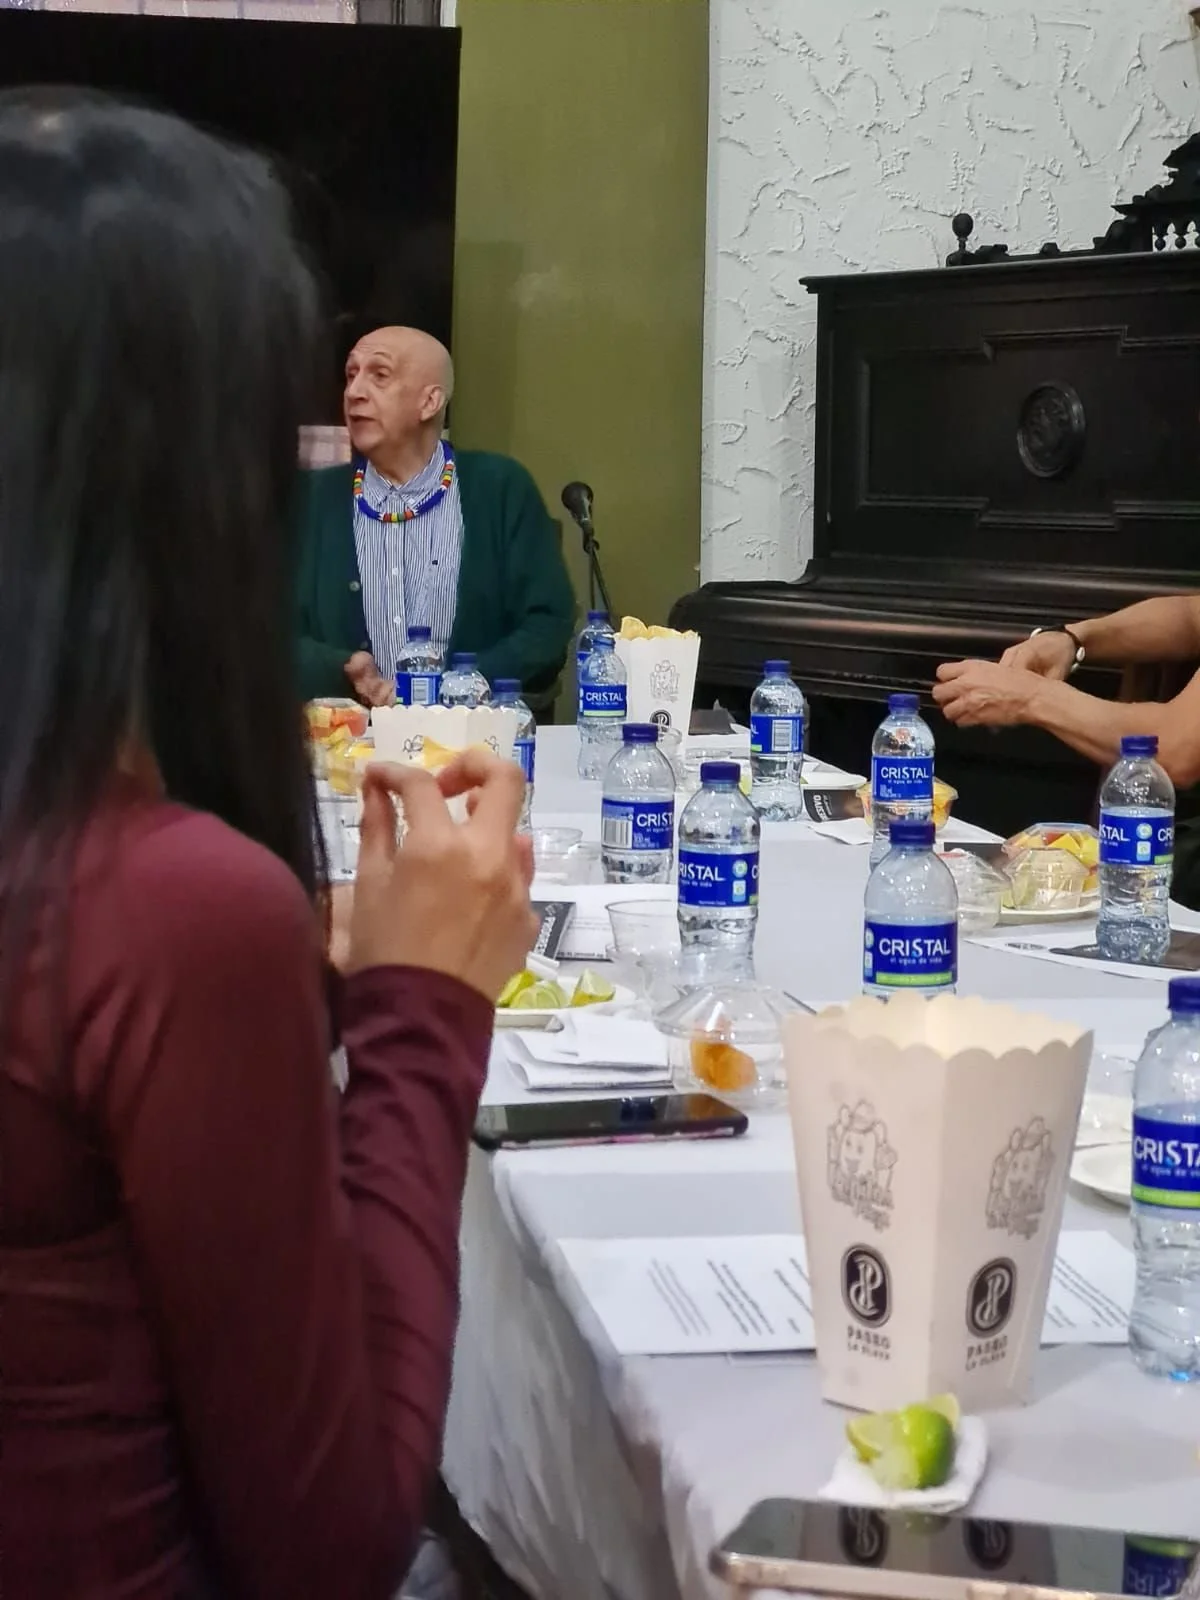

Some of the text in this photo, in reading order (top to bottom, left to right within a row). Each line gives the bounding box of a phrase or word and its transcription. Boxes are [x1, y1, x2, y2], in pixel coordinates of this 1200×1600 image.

[585, 692, 624, 702] CRISTAL
[880, 766, 930, 779] CRISTAL
[636, 812, 673, 827] CRIST
[1099, 824, 1131, 842] STAL
[679, 862, 727, 882] RISTAL
[878, 938, 951, 957] CRISTAL
[1133, 1136, 1200, 1168] CRIST
